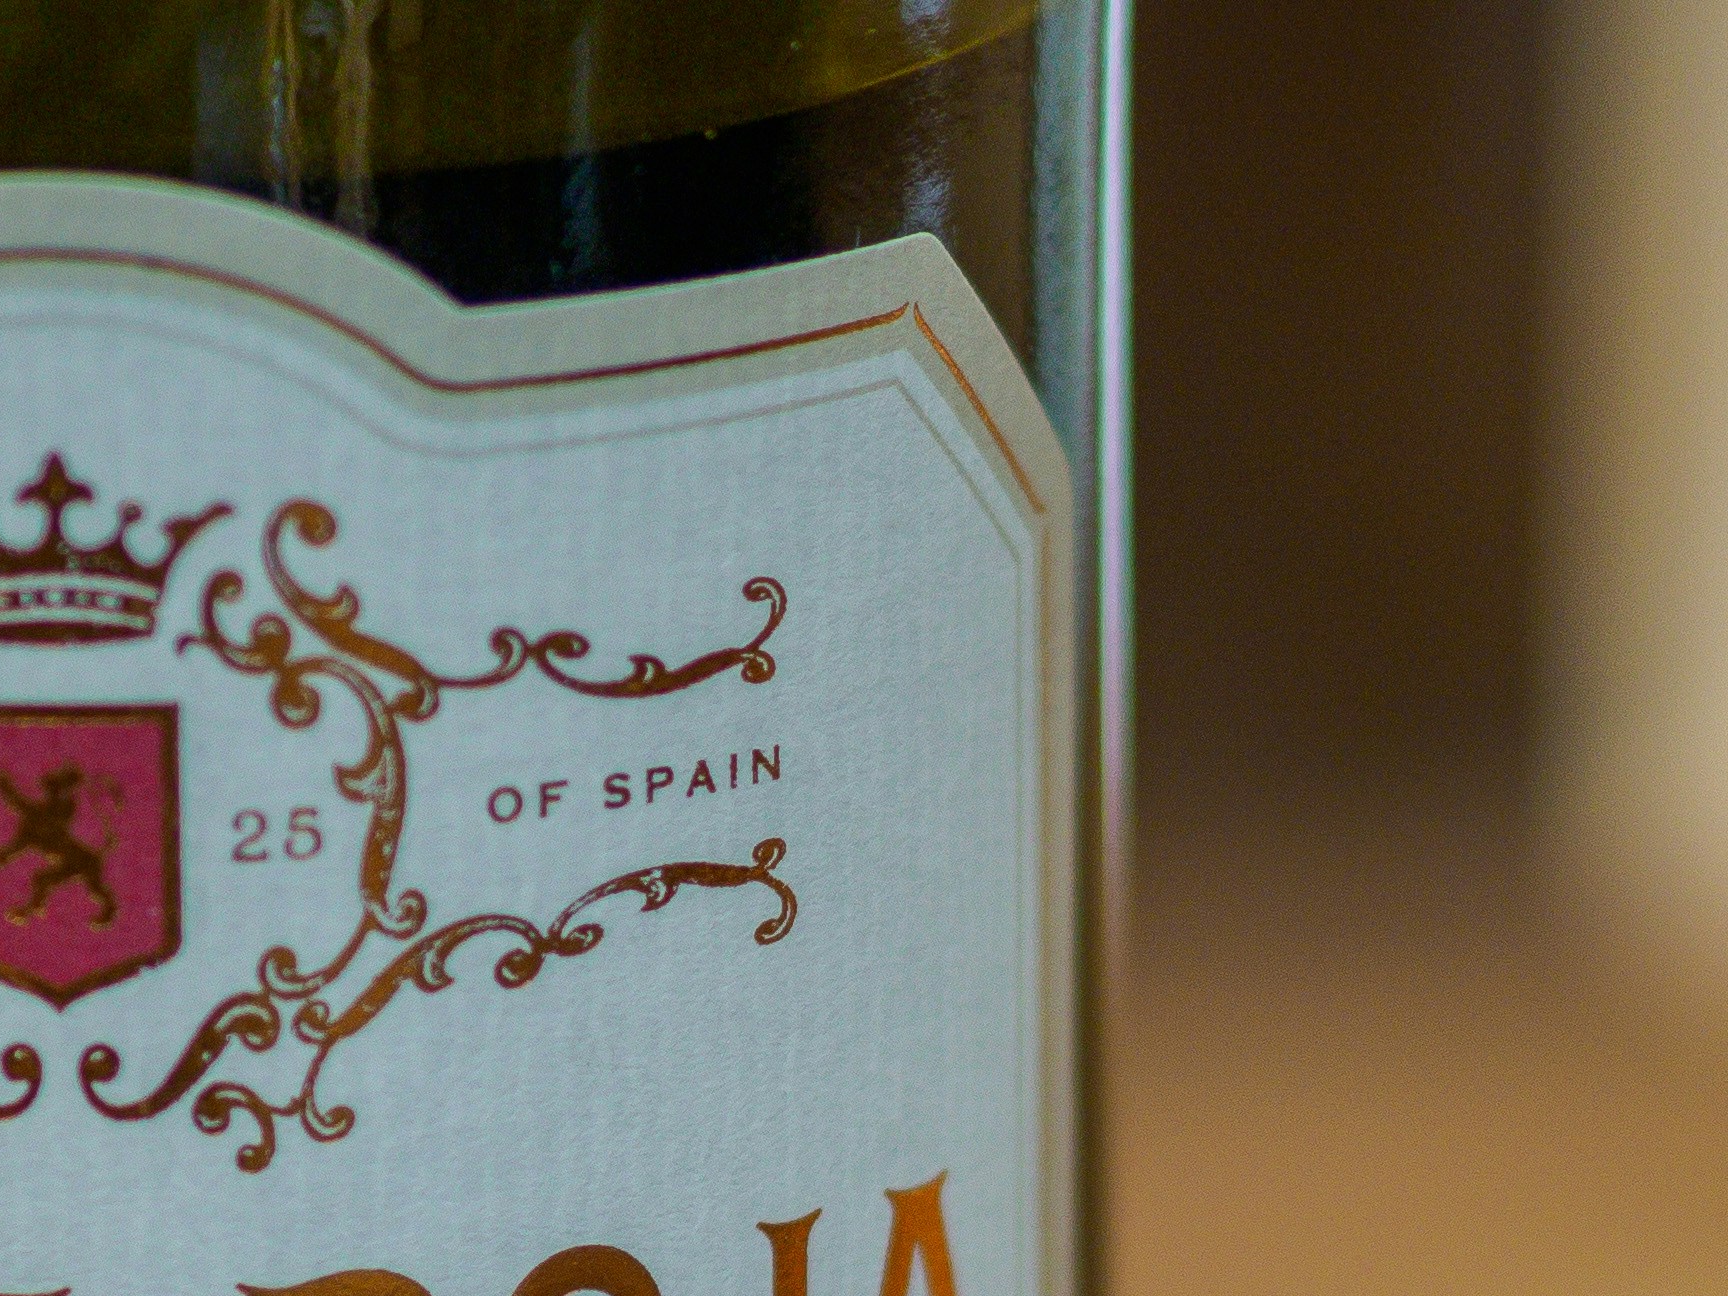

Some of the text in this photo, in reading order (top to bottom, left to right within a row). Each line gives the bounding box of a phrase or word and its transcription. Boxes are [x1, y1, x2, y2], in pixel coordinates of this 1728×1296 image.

[485, 744, 783, 825] OF SPAIN
[230, 806, 325, 863] 25
